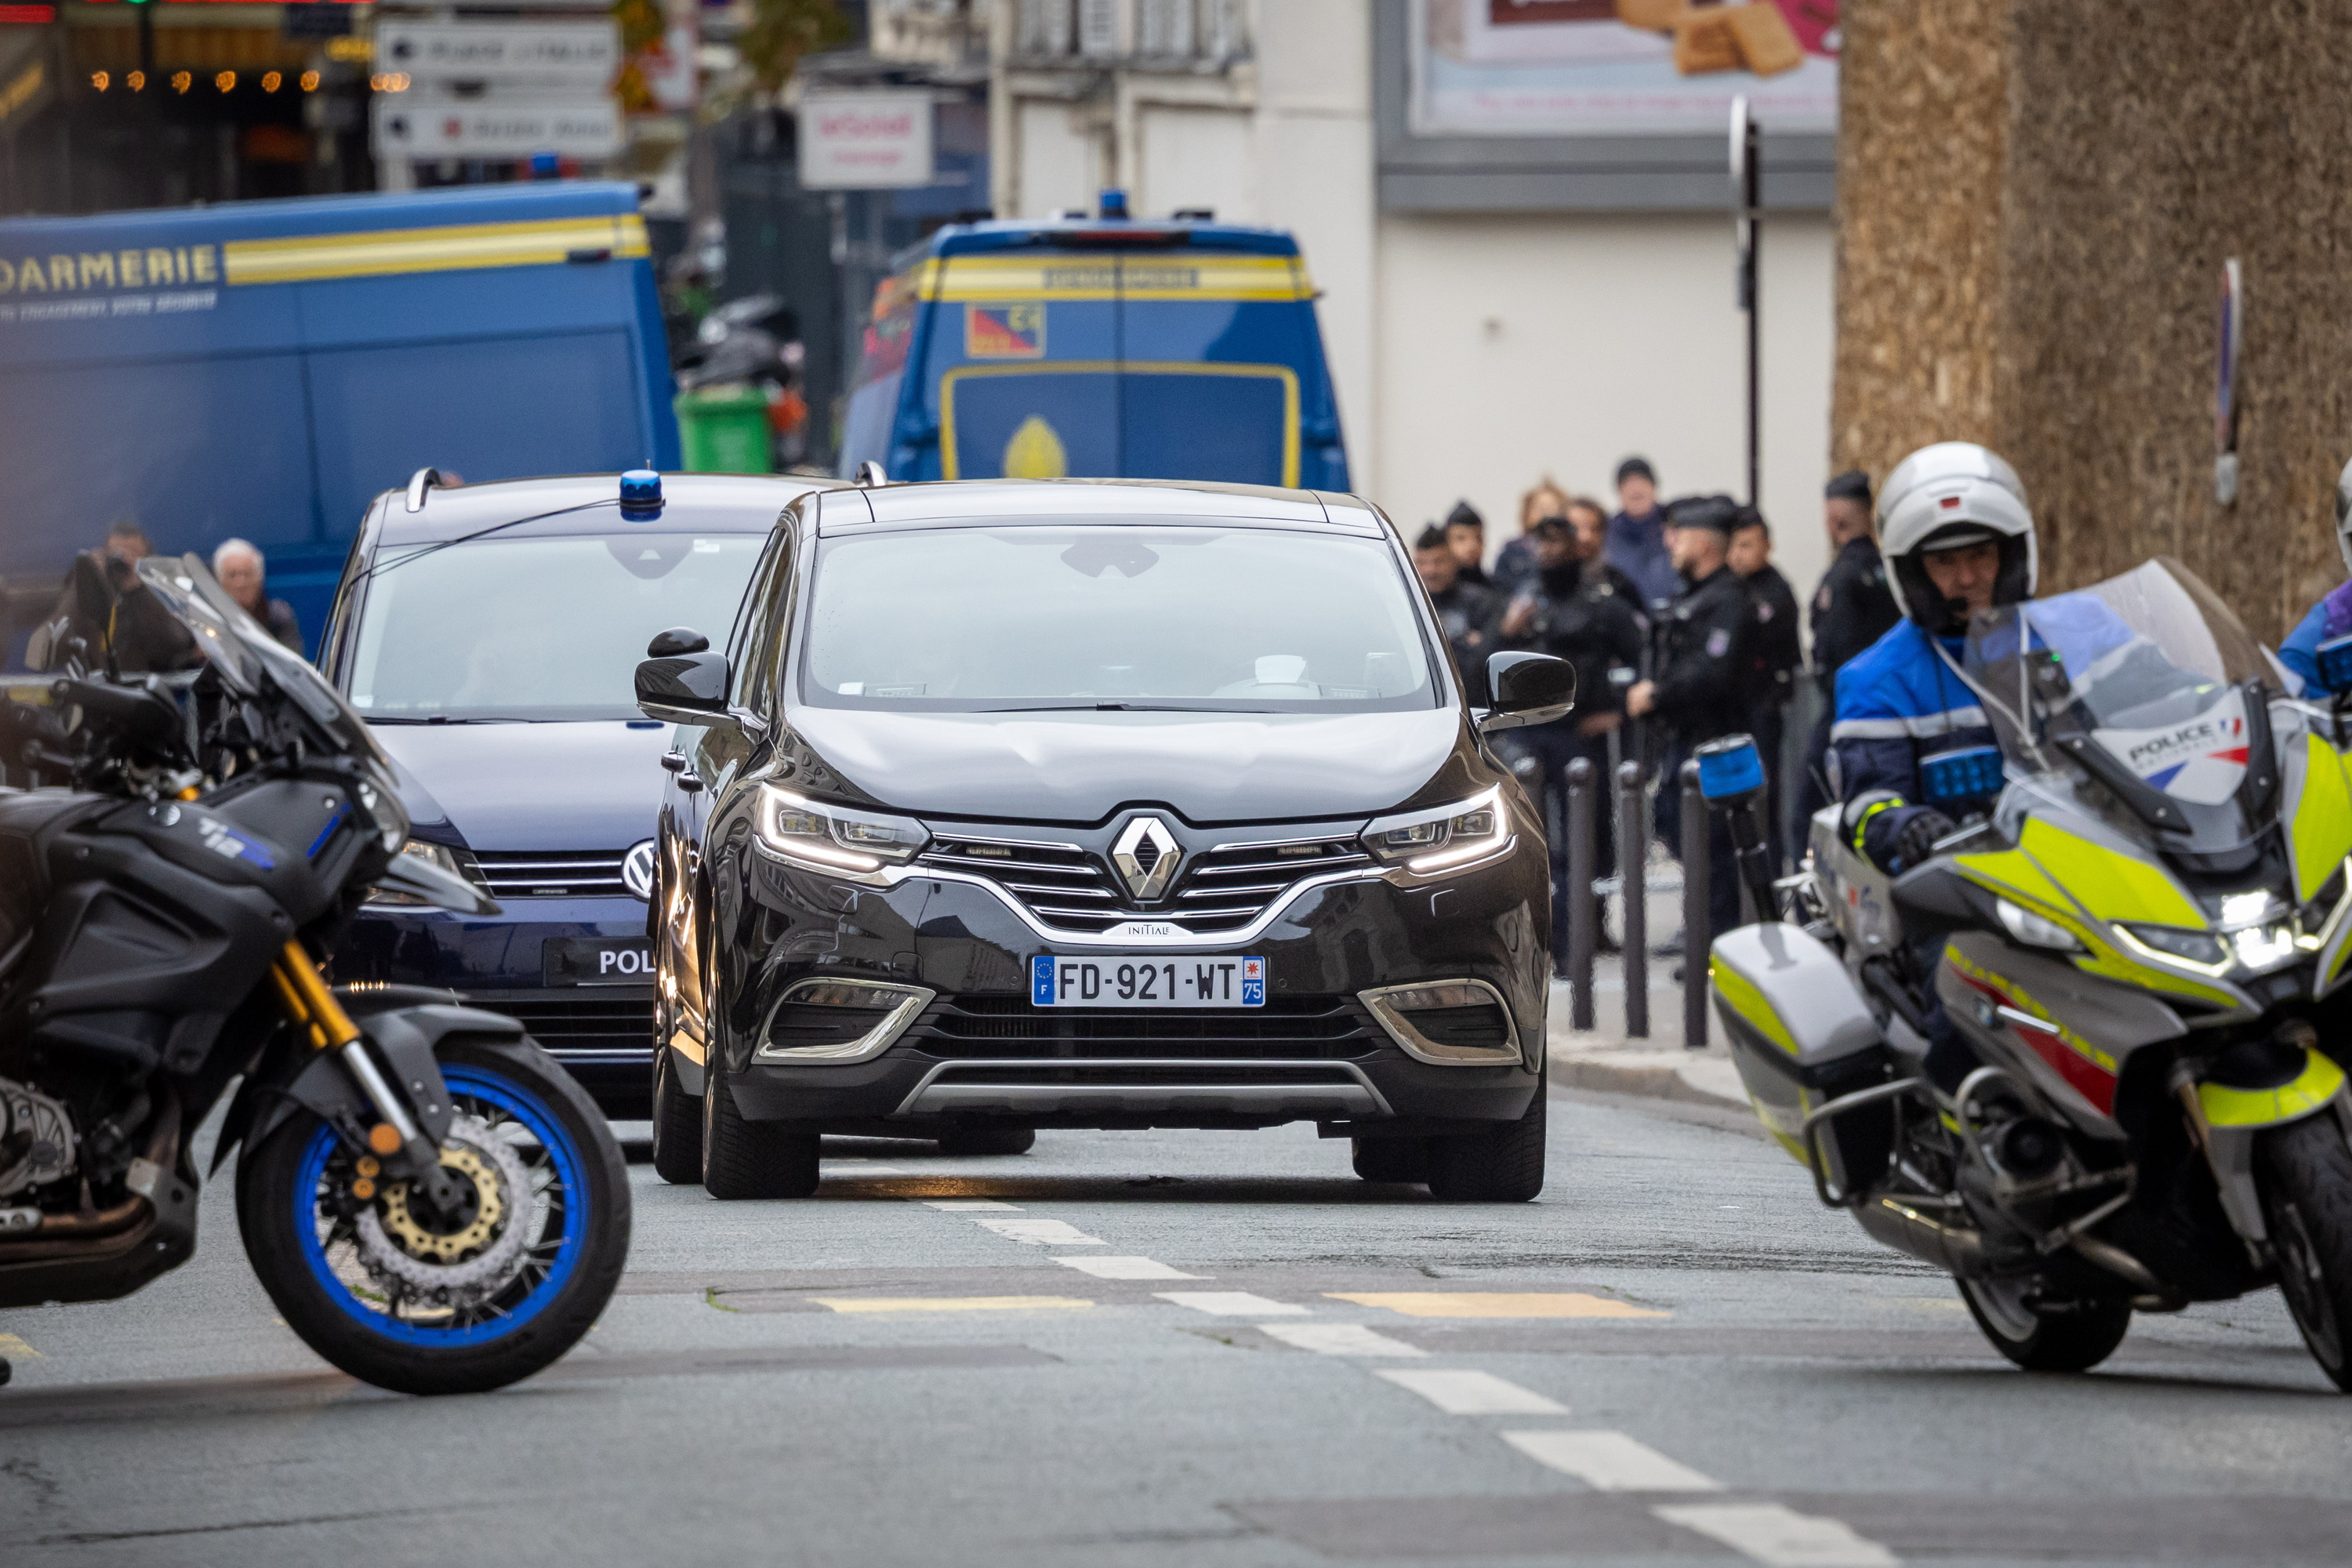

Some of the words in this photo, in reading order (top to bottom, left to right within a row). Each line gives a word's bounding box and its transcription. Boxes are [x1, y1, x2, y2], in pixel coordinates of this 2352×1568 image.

[2129, 723, 2214, 761] POLICE
[1127, 924, 1170, 935] INITIALE
[1040, 985, 1047, 995] F
[1059, 964, 1236, 1000] FD-921-WT
[1244, 982, 1262, 1000] 75
